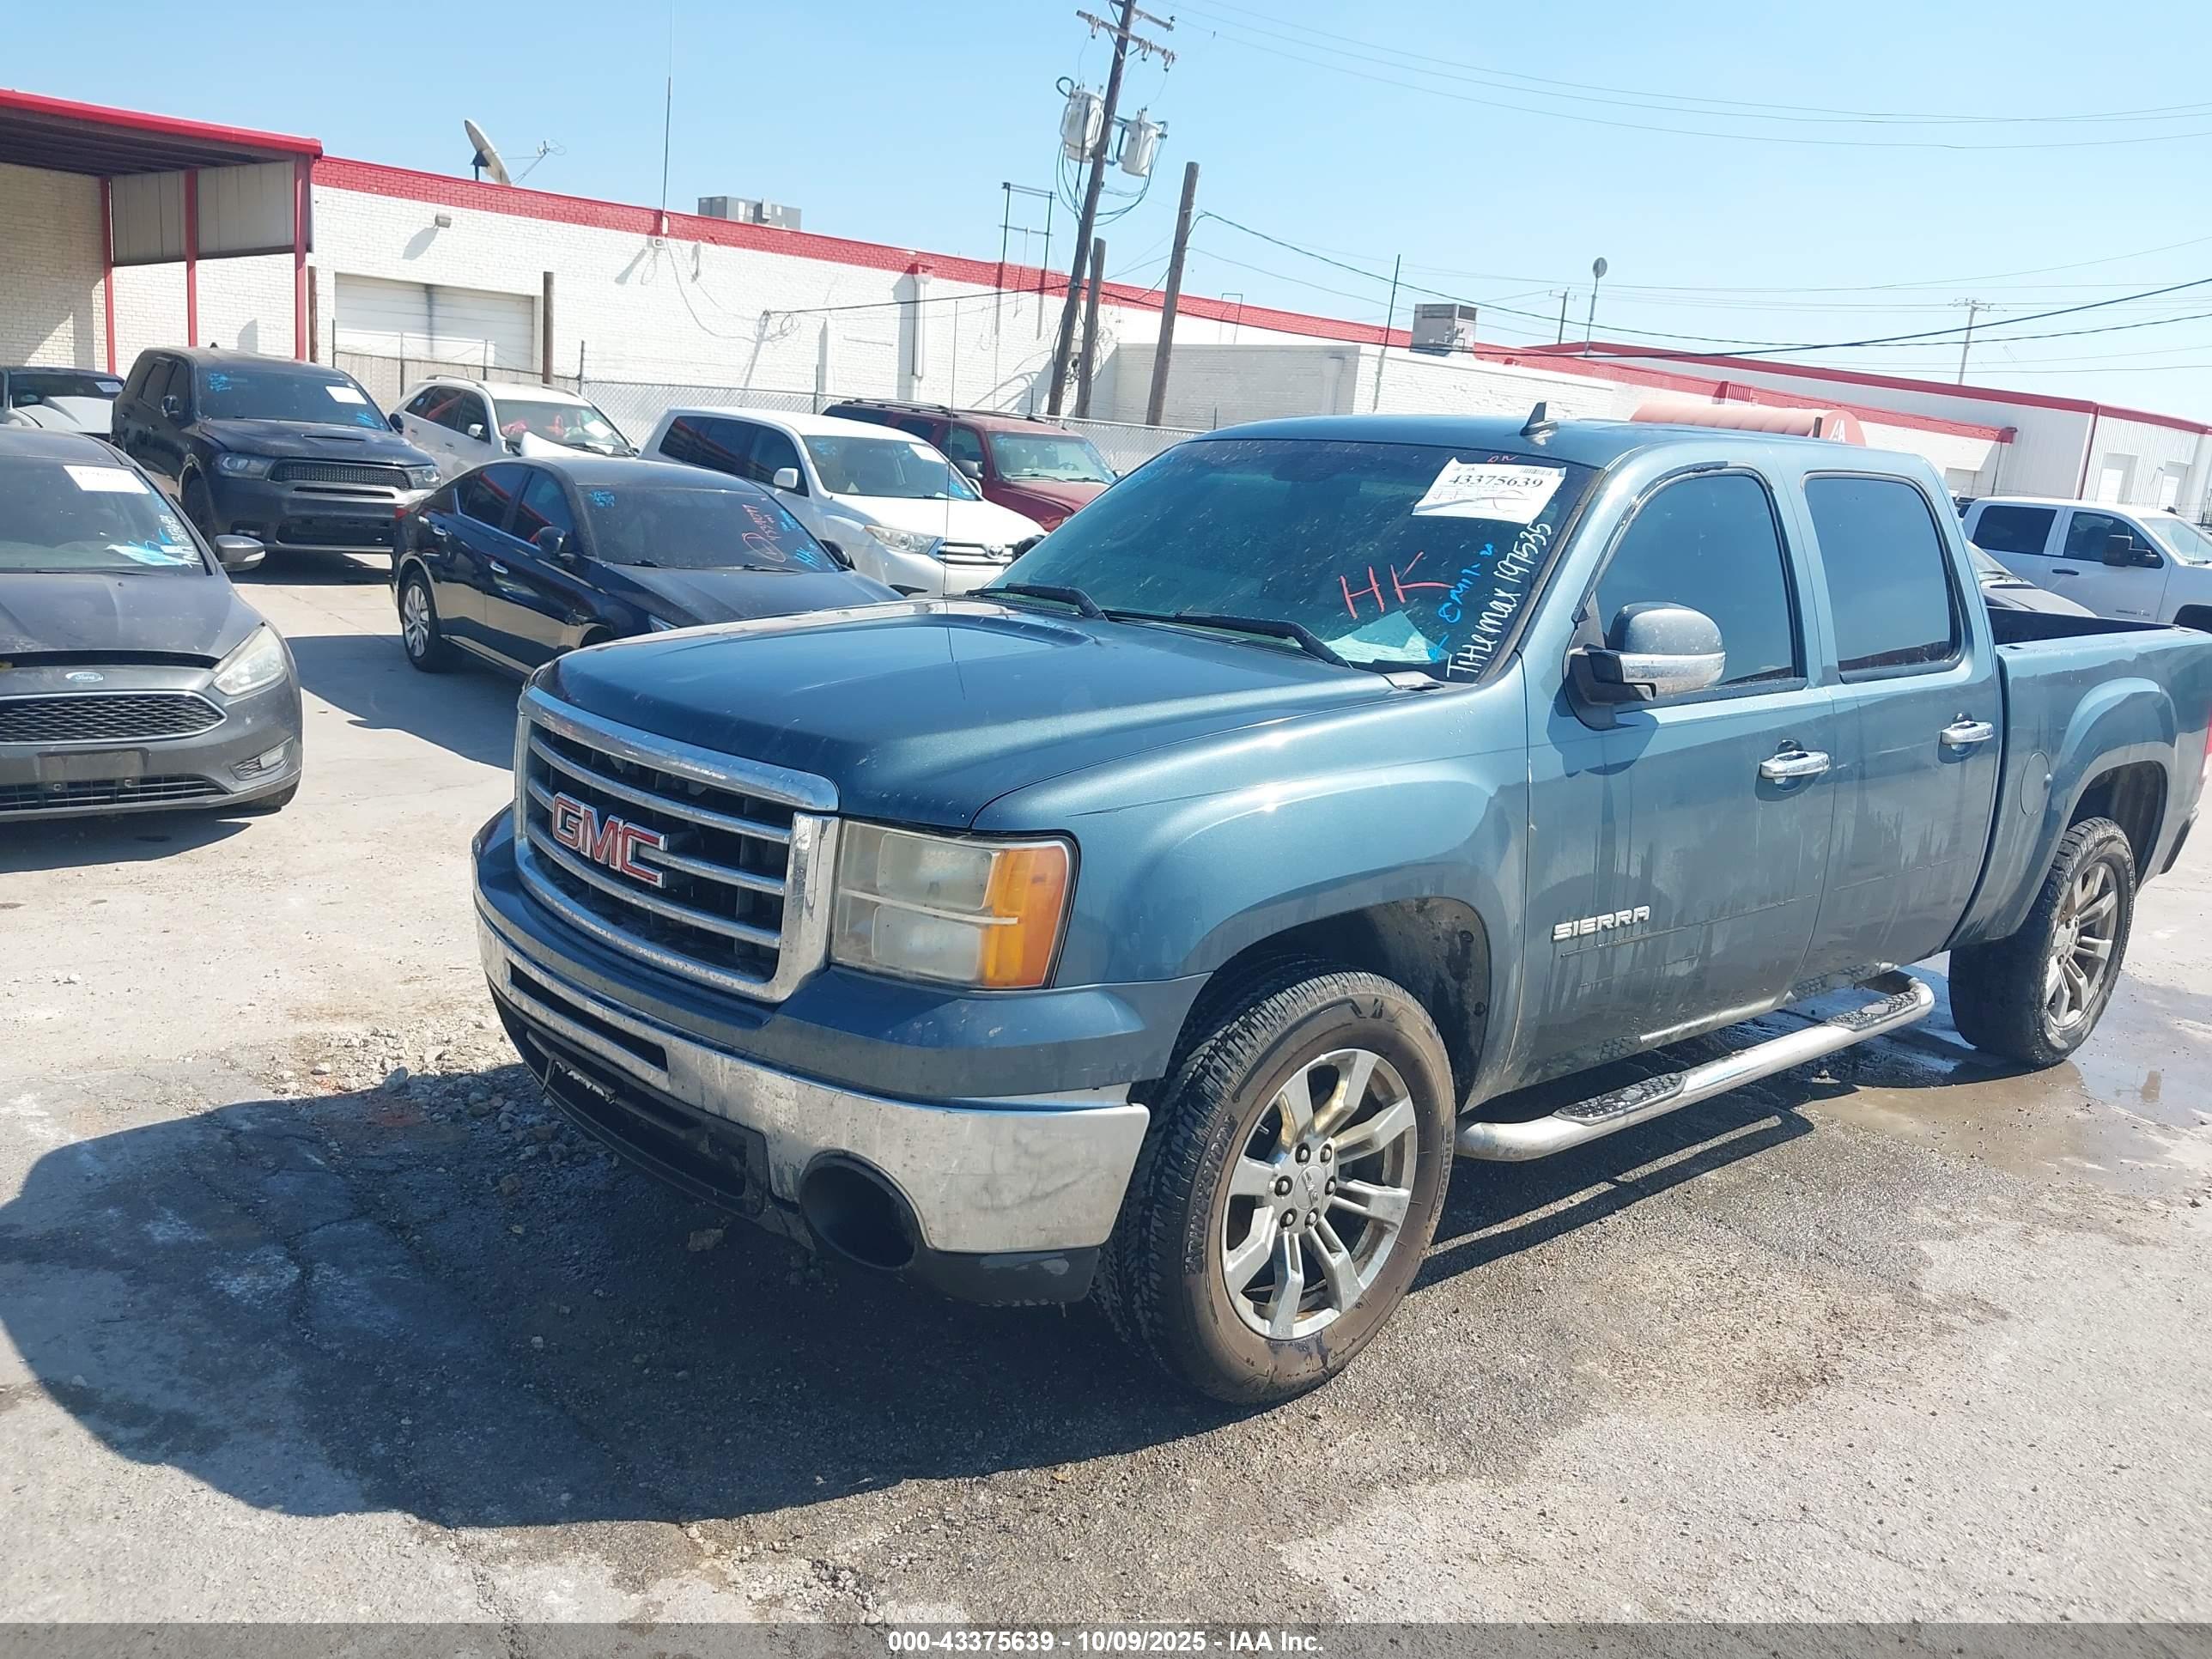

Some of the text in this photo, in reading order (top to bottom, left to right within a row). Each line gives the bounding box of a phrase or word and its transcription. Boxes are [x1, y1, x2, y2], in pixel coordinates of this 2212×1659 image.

[1449, 474, 1544, 489] 43375639
[1493, 520, 1553, 584] 197535
[552, 792, 669, 889] GMC
[1552, 905, 1650, 941] SIERRA
